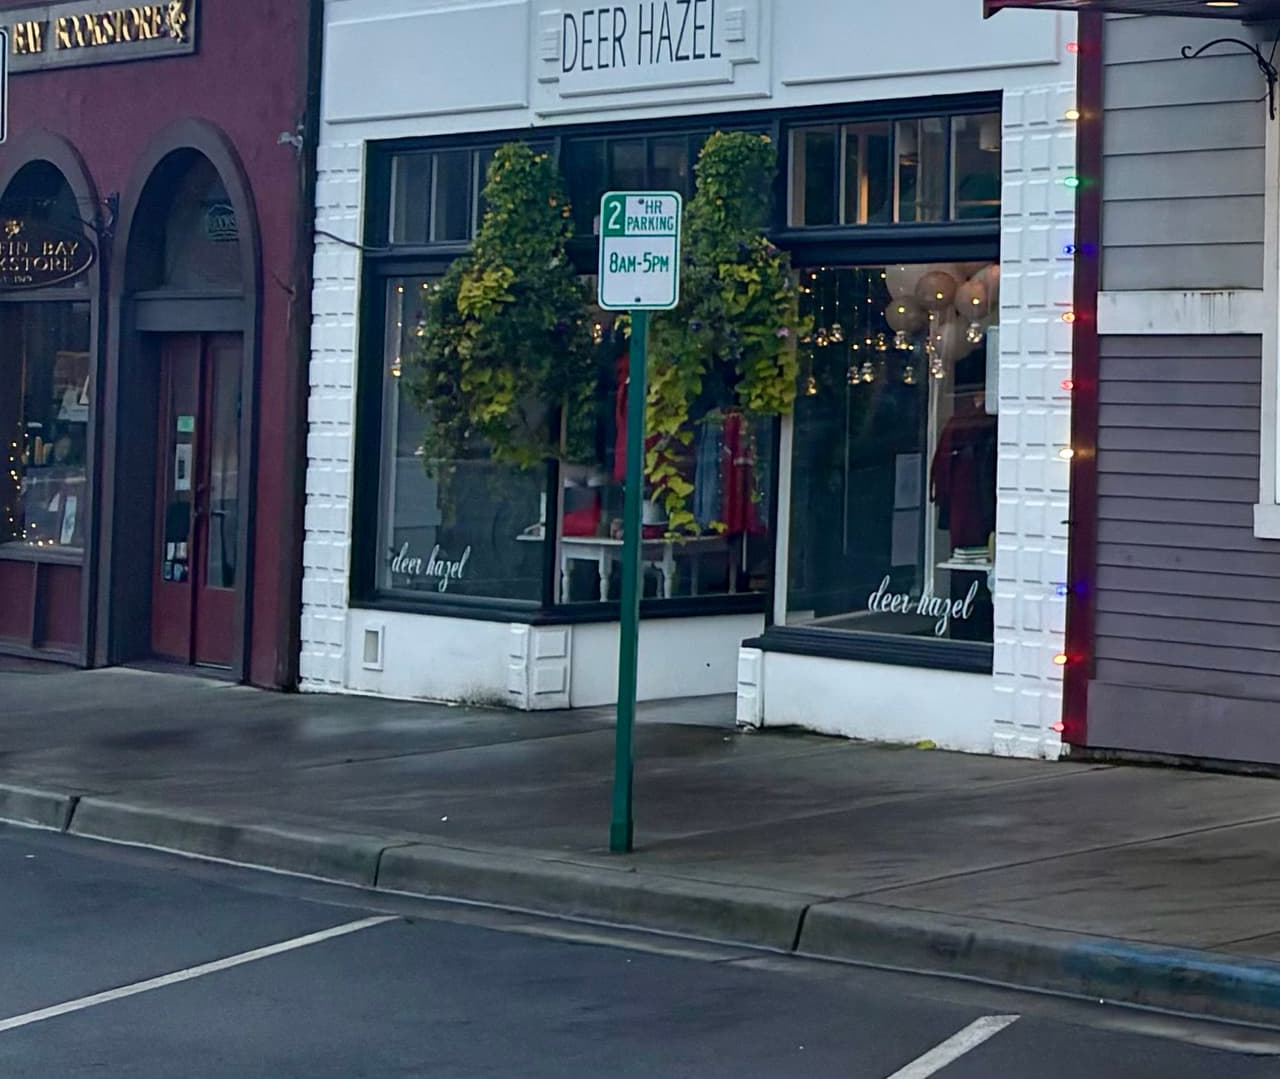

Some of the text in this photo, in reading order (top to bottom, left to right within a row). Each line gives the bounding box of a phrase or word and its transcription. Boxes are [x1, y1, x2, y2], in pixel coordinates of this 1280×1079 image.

[12, 5, 163, 55] BAY BOOKSTORE
[561, 6, 628, 74] DEER
[607, 200, 663, 230] 2 HR
[626, 215, 675, 232] PARKING
[43, 240, 79, 256] BAY
[609, 251, 670, 274] 8AM-5PM
[391, 541, 471, 593] deer hazel
[867, 574, 979, 636] deer hazel
